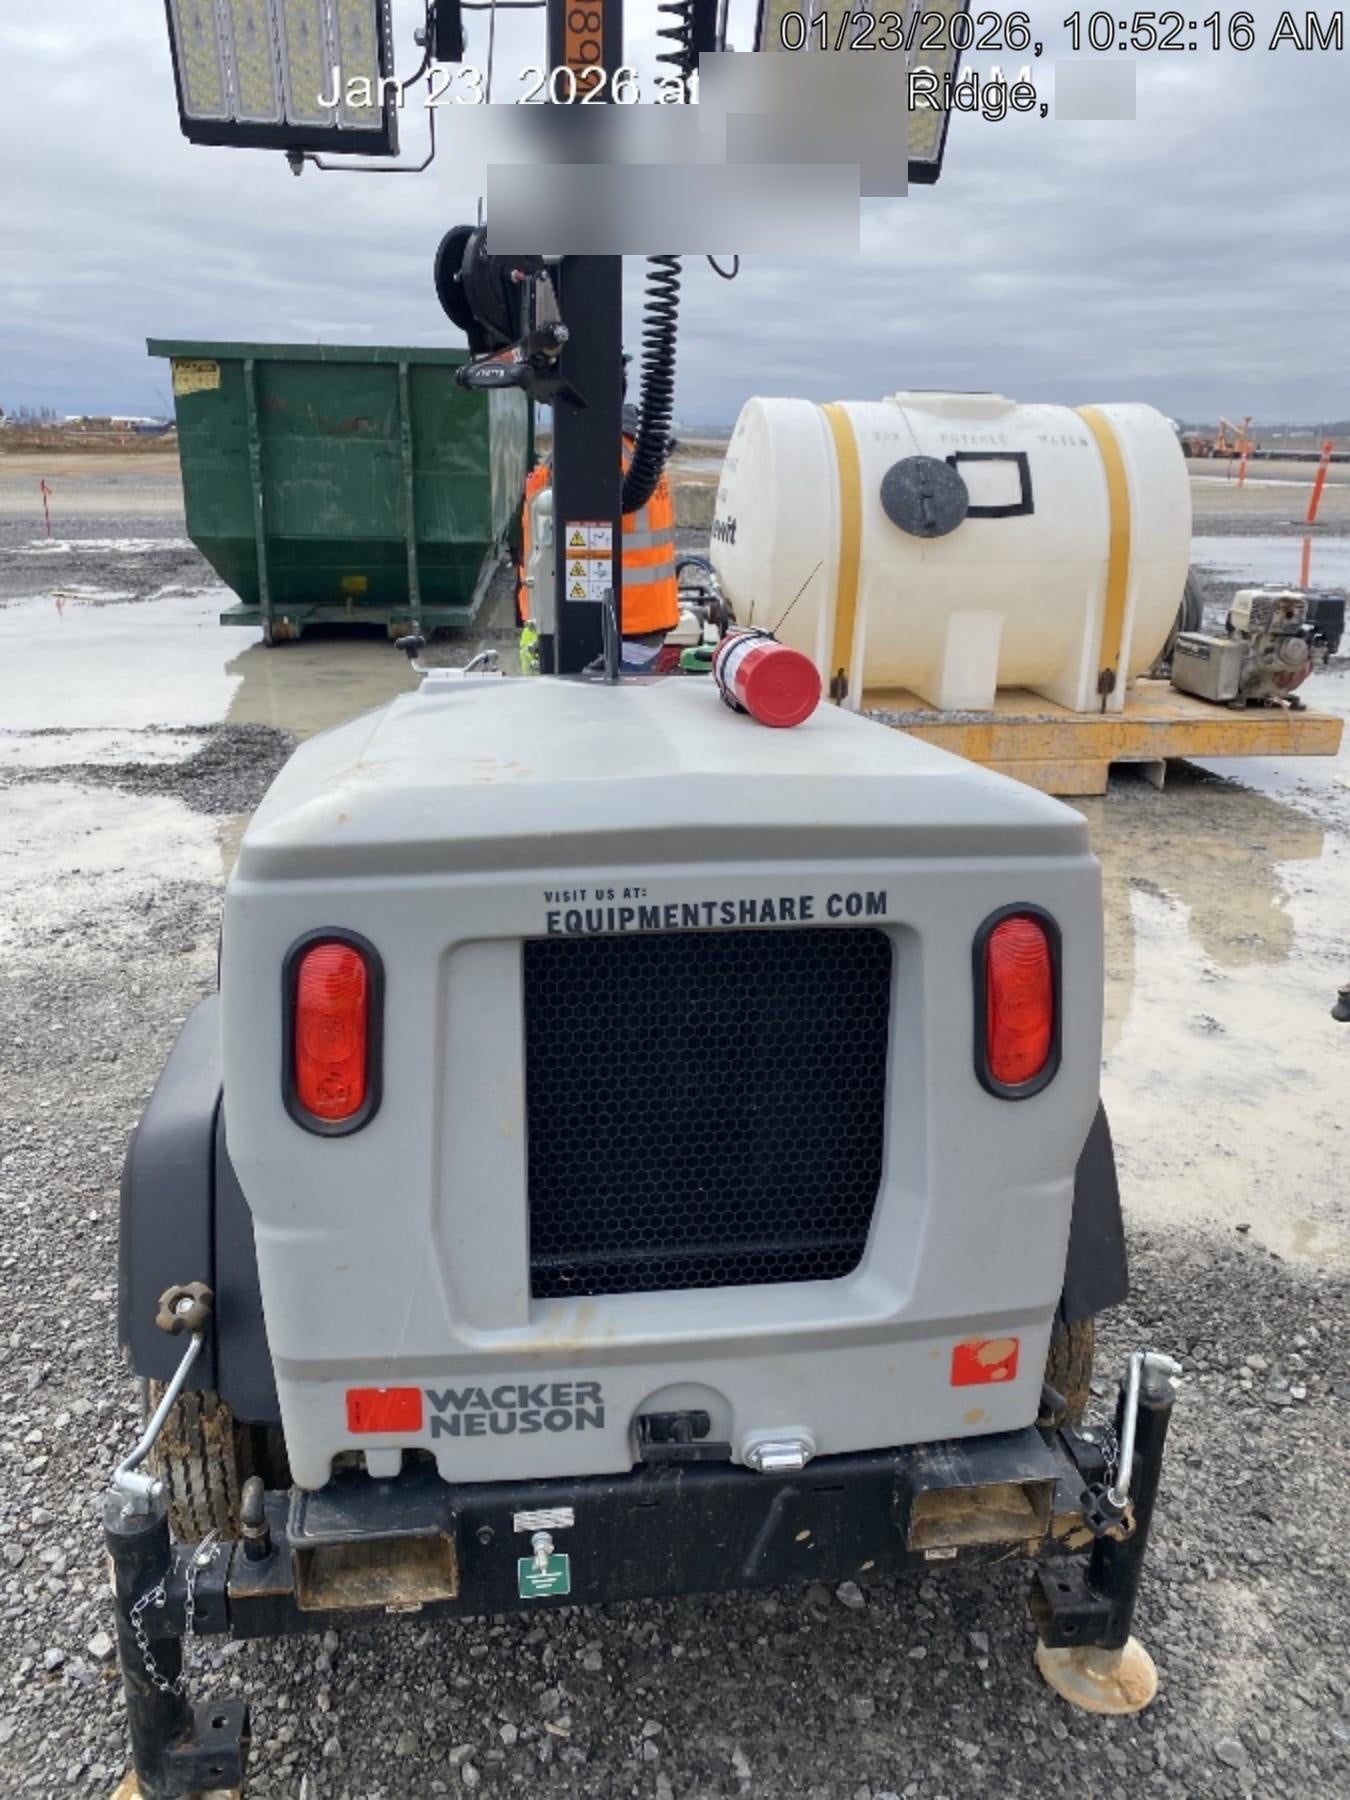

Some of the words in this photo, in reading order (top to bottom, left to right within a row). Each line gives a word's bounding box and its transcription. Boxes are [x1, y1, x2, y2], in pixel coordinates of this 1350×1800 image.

[543, 889, 586, 903] VISIT
[595, 889, 615, 901] US
[623, 887, 647, 899] AT:
[546, 894, 815, 934] EQUIPMENTSHARE
[826, 890, 887, 918] COM
[424, 1381, 604, 1413] WACKER
[430, 1406, 605, 1438] NEUSON
